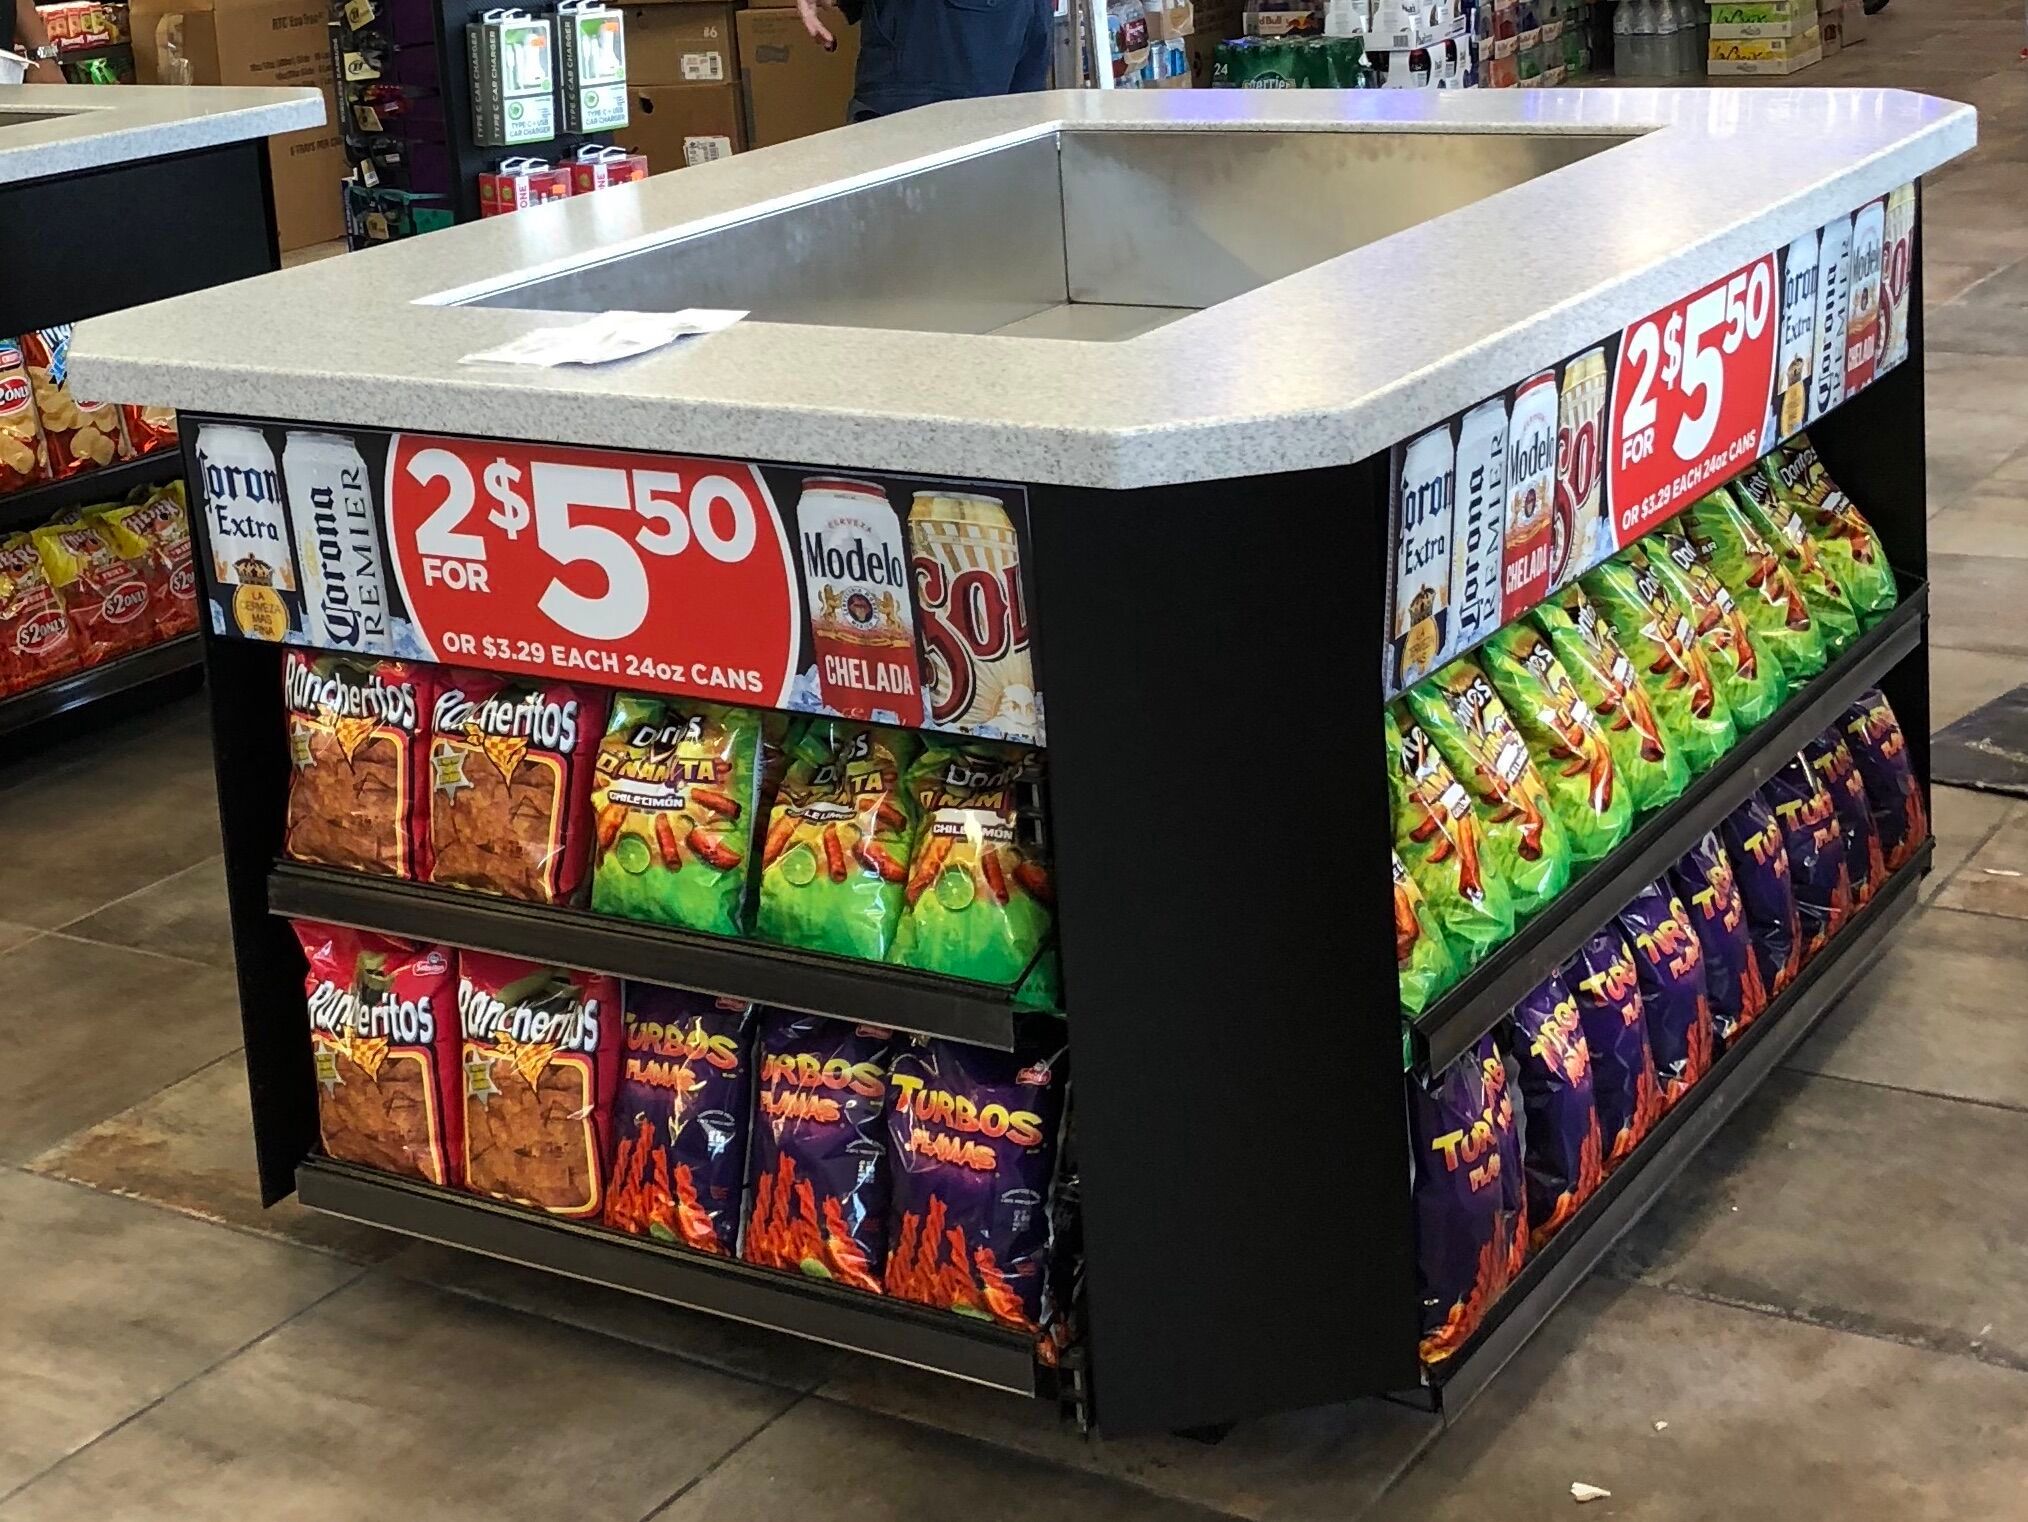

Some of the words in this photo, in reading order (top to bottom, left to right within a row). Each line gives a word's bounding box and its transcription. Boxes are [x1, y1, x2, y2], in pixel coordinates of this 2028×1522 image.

[1214, 63, 1228, 76] 24
[519, 185, 528, 208] ONE
[1622, 321, 1660, 440] 2
[1509, 425, 1555, 487] Modelo
[1620, 427, 1656, 472] FOR
[405, 447, 487, 562] 2
[1622, 506, 1640, 531] OR
[1640, 487, 1671, 521] $3.29
[1672, 467, 1703, 502] EACH
[1702, 456, 1729, 481] 24oz
[1728, 431, 1757, 463] CANS
[214, 505, 280, 543] Extra
[308, 486, 362, 648] Corona
[422, 558, 491, 594] FOR
[804, 531, 904, 588] Modelo
[1404, 534, 1446, 576] Extra
[1505, 542, 1548, 596] CHELADA
[442, 630, 477, 656] OR
[482, 632, 546, 666] $3.29
[551, 647, 619, 677] EACH
[625, 653, 686, 684] 24oz
[693, 662, 764, 693] CANS
[824, 654, 915, 696] CHELADA
[891, 1073, 1044, 1146] TURBOS
